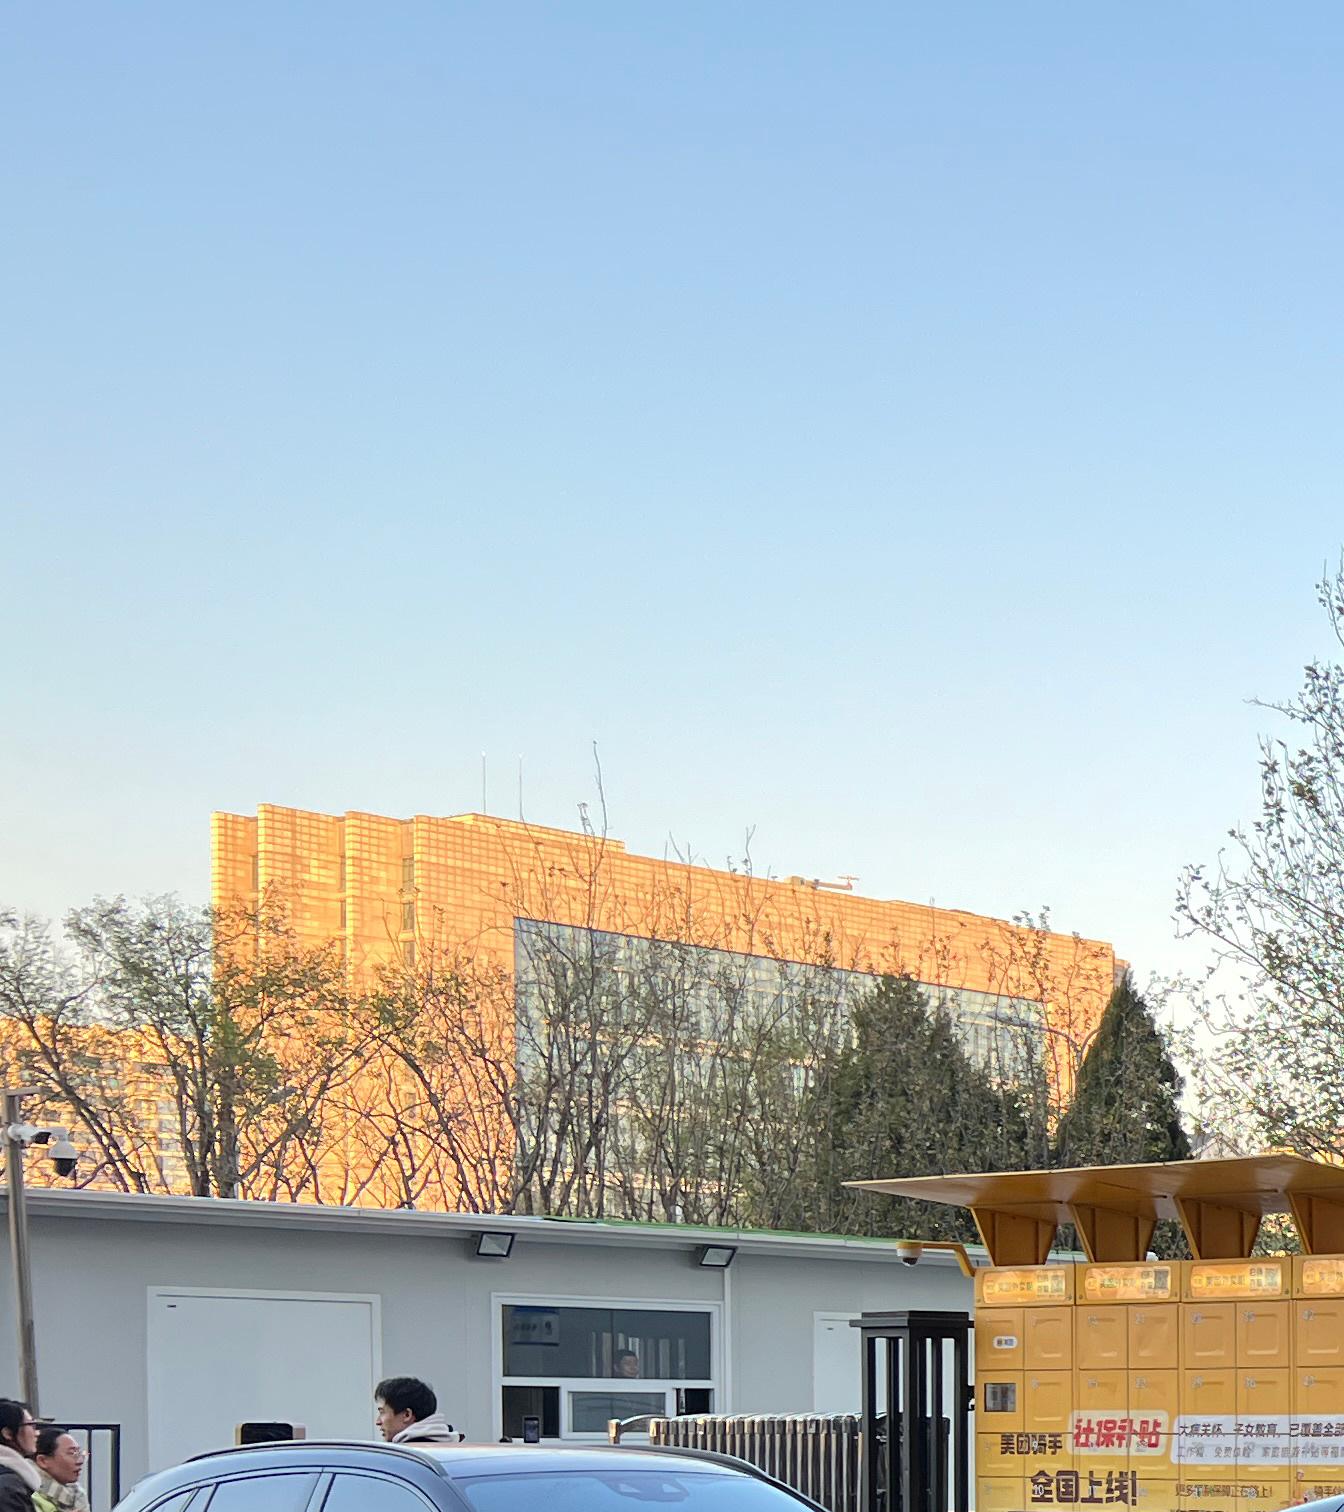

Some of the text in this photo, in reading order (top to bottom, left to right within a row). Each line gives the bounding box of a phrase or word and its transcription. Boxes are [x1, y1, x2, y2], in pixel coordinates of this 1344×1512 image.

[1001, 1433, 1063, 1456] 美团骑手
[1073, 1418, 1162, 1449] 社保补贴
[1031, 1469, 1137, 1507] 全国上线!
